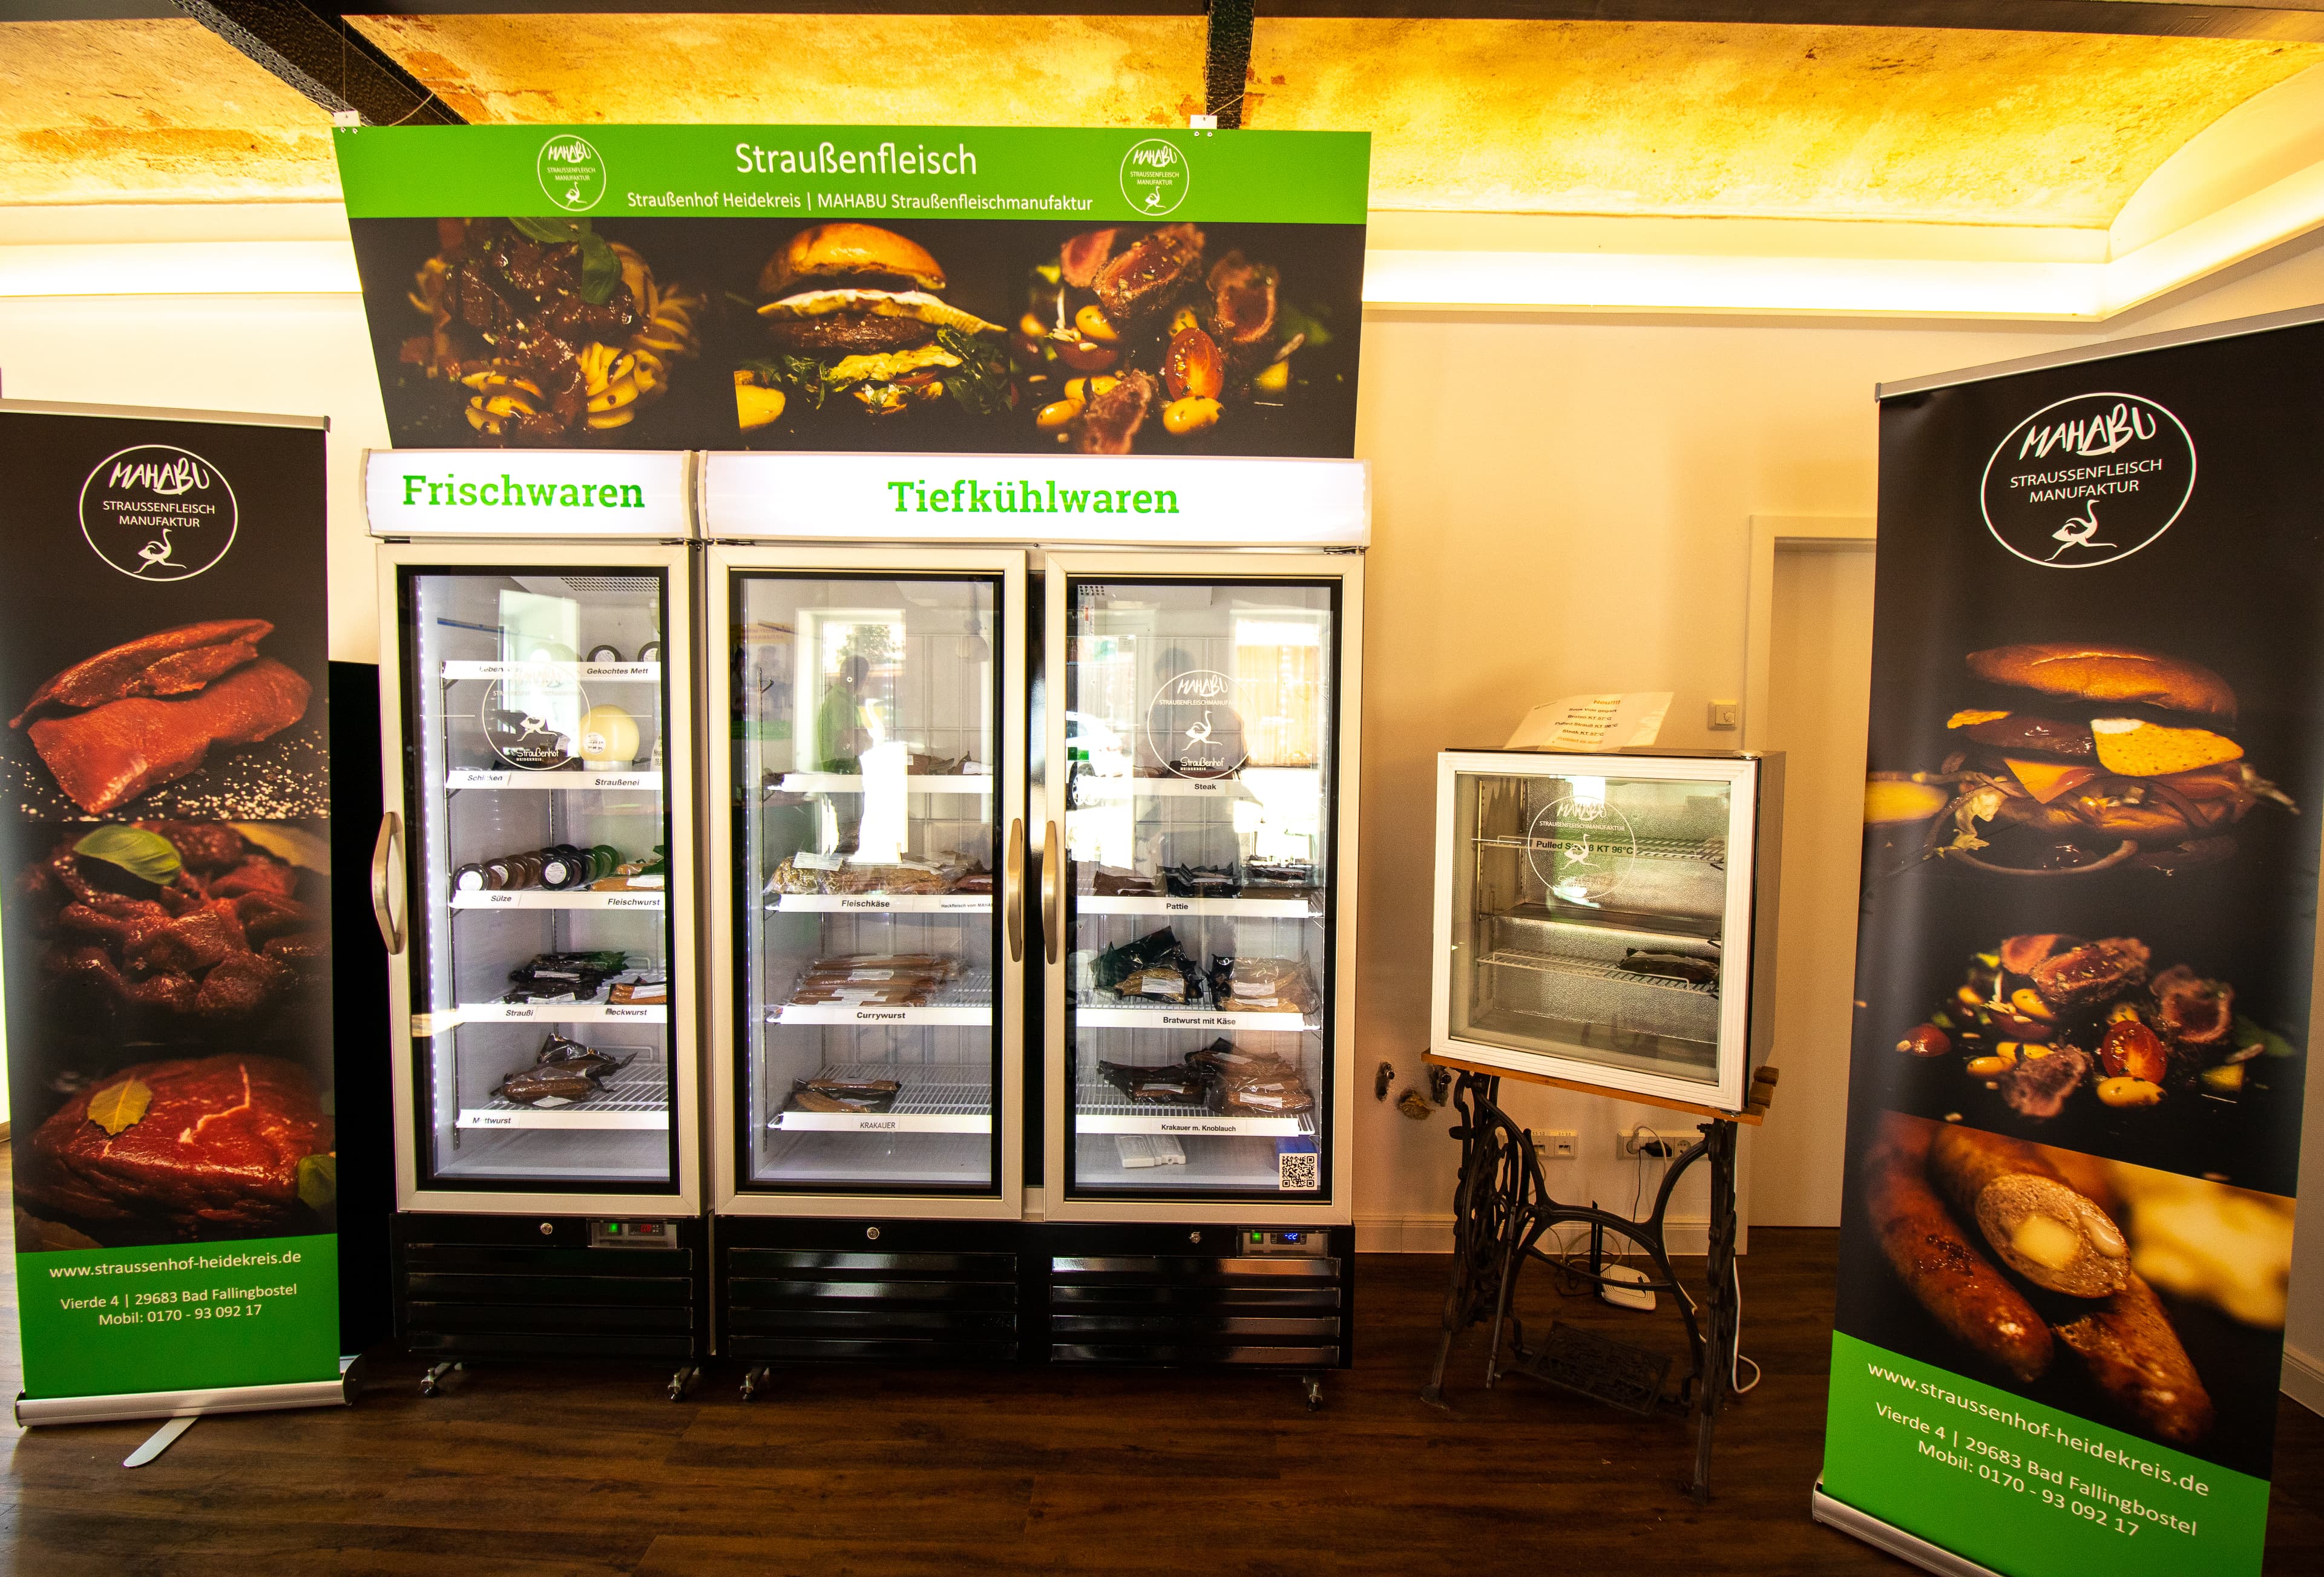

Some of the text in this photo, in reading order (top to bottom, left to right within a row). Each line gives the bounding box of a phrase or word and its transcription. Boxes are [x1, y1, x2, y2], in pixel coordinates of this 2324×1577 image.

[548, 140, 591, 163] MAHABU
[735, 142, 977, 174] Straußenfleisch
[1132, 145, 1177, 167] MAHABU
[627, 191, 719, 208] Straußenhof
[723, 191, 801, 208] Heidekreis
[818, 194, 887, 209] MAHABU
[891, 193, 1093, 211] Straußenfleischmanufaktur
[2018, 403, 2156, 461] MAHABU
[109, 457, 210, 496] MAHABU
[2010, 458, 2163, 488] STRAUSSENFLEISCH
[402, 474, 646, 510] Frischwaren
[888, 479, 1180, 516] Tiefkühlwaren
[2029, 480, 2139, 503] MANUFAKTUR
[103, 501, 215, 514] STRAUSSENFLEISCH
[119, 516, 200, 527] MANUFAKTUR
[1177, 675, 1229, 697] MAHABU
[1180, 756, 1225, 767] Straußenhof
[1536, 841, 1563, 850] Pulled
[1612, 846, 1633, 854] 96°C
[50, 1250, 301, 1278] www.straussenhof-heidekreis.de
[61, 1296, 107, 1310] Vierde
[110, 1296, 119, 1307] 4
[134, 1292, 178, 1306] 29683
[182, 1289, 208, 1302] Bad
[212, 1284, 297, 1300] Fallingbostel
[98, 1312, 144, 1326] Mobil:
[147, 1310, 182, 1322] 0170
[195, 1307, 212, 1320] 93
[215, 1305, 241, 1318] 092
[245, 1304, 263, 1316] 17
[1867, 1362, 2210, 1497] www.straussenhof-heidekreis.de
[1875, 1402, 1930, 1434] Vierde
[1934, 1426, 1946, 1440] 4
[1965, 1437, 2021, 1469] 29683
[2027, 1460, 2063, 1486] Bad
[2069, 1476, 2198, 1536] Fallingbostel
[1917, 1440, 1974, 1474] Mobil:
[1978, 1464, 2025, 1493] 0170
[2041, 1489, 2066, 1509] 93
[2070, 1500, 2107, 1527] 092
[2114, 1517, 2139, 1537] 17
